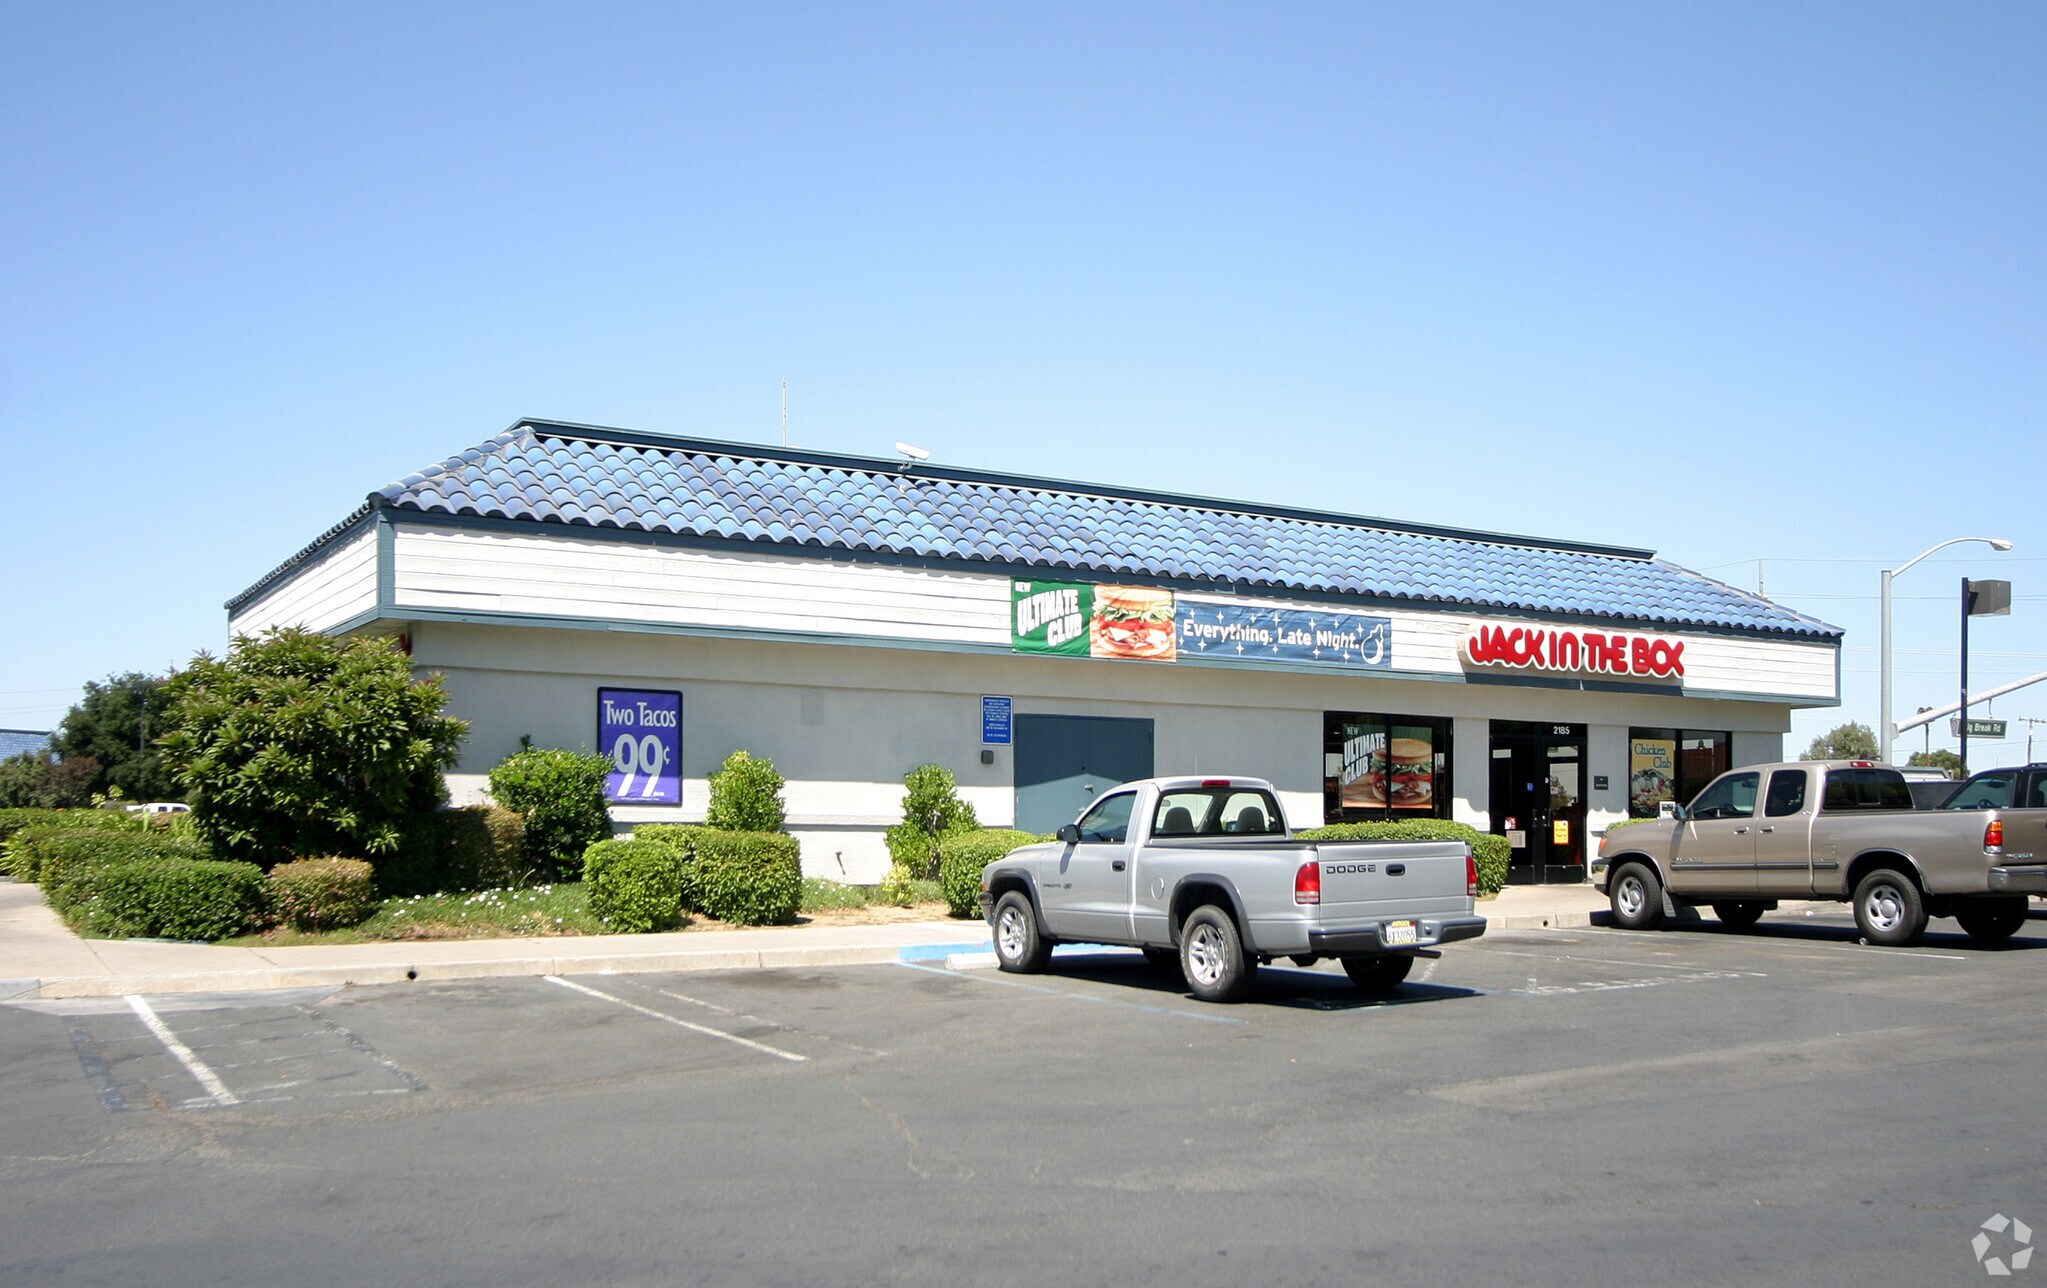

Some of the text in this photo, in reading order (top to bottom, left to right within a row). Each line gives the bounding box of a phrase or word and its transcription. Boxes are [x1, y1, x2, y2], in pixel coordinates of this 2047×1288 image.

[1015, 581, 1031, 592] NEW
[1017, 589, 1079, 637] ULTIMATE
[1047, 612, 1083, 647] CLUB
[1183, 618, 1360, 651] Everything. Late Night.
[1469, 625, 1544, 667] JACK
[1582, 632, 1628, 672] THE
[1631, 636, 1685, 676] BOX
[603, 700, 677, 727] Two Tacos
[1347, 727, 1359, 735] NEW
[1553, 726, 1570, 735] 2185
[1975, 722, 1991, 732] Break
[1993, 723, 2002, 732] Rd
[1344, 732, 1386, 767] ULTIMATE
[1634, 742, 1666, 756] Chicken
[1344, 755, 1369, 786] CLUB
[1653, 756, 1672, 768] Club
[1326, 864, 1376, 875] DODGE
